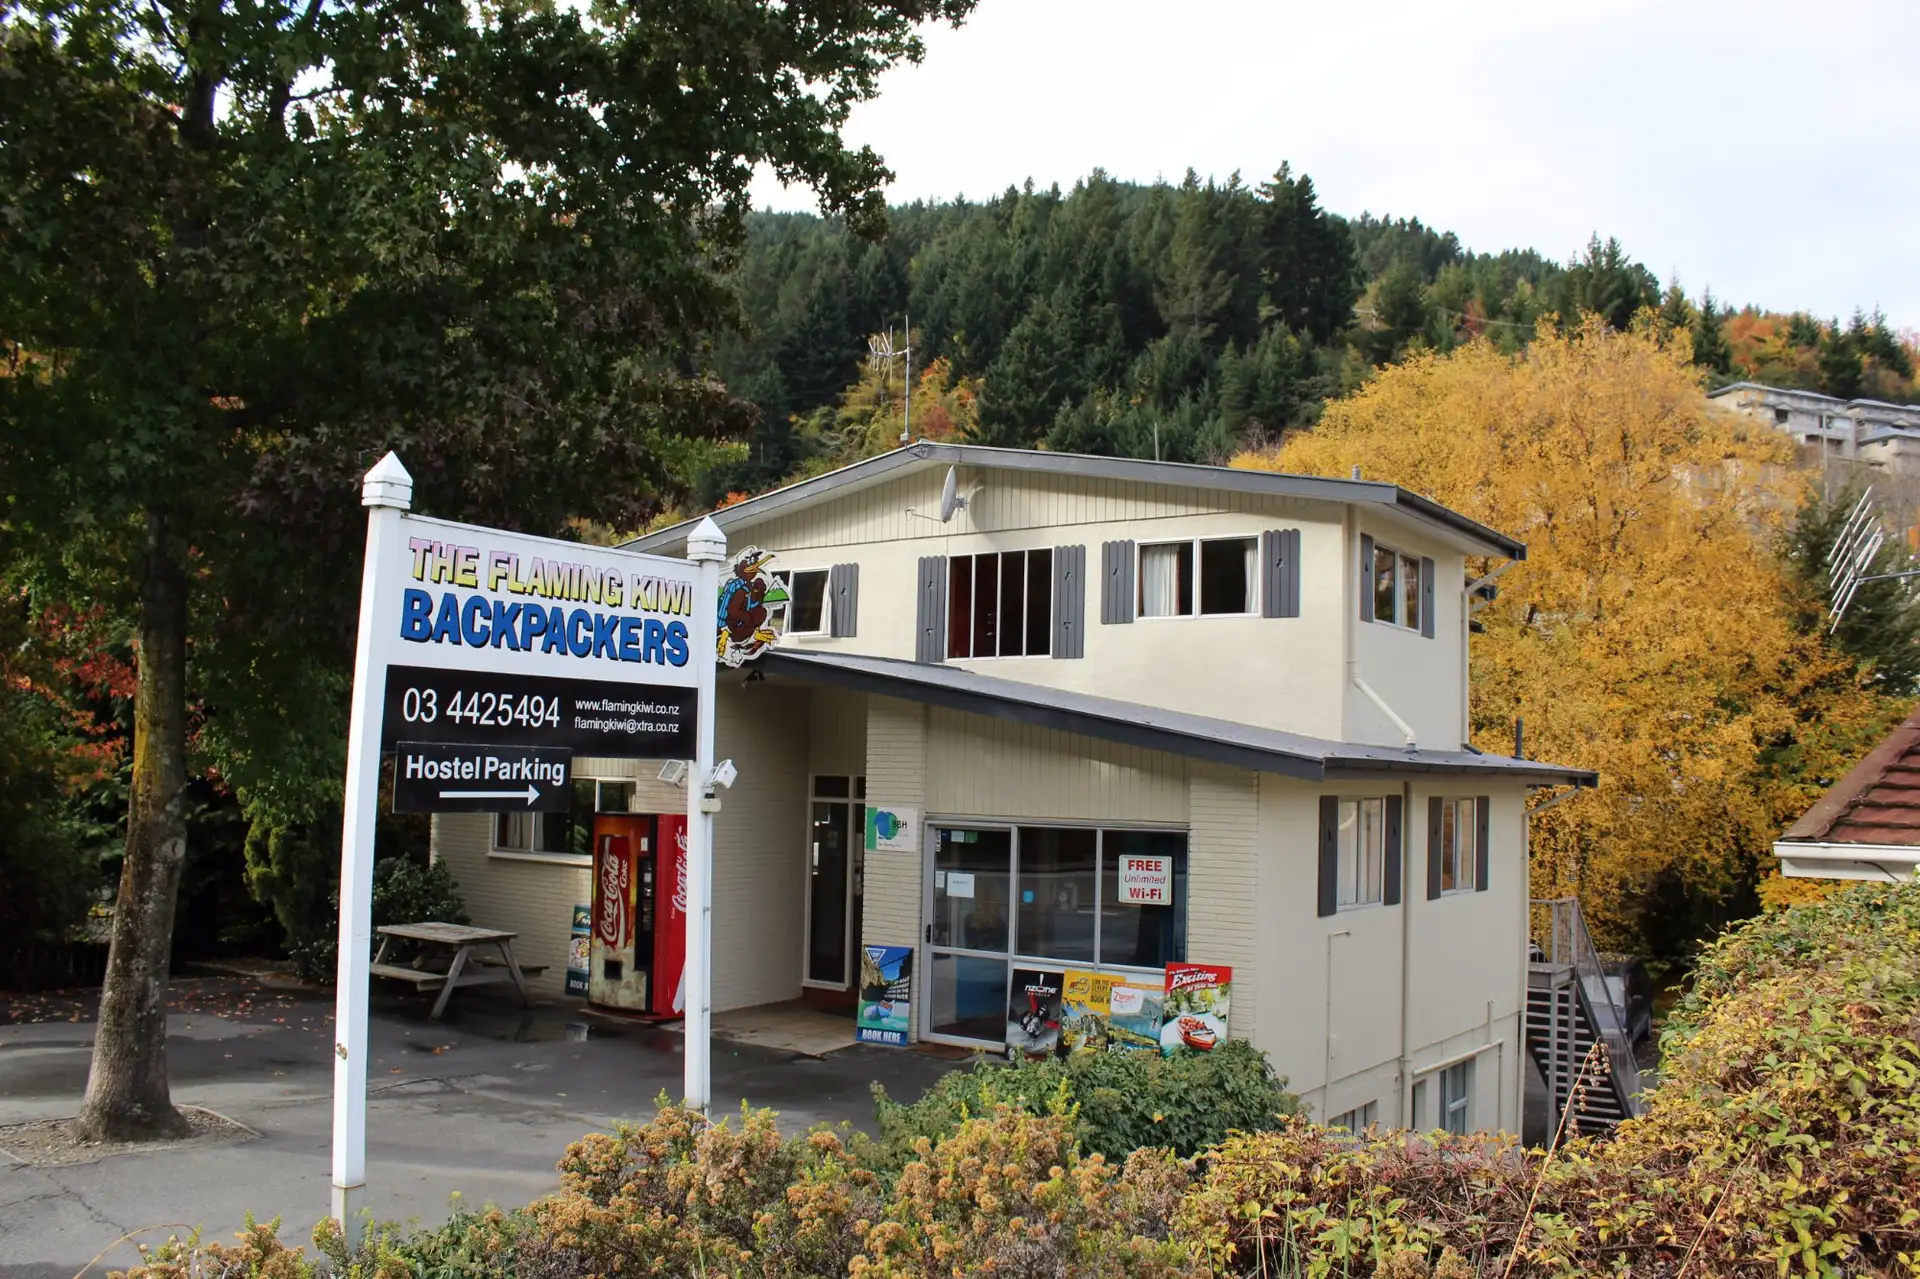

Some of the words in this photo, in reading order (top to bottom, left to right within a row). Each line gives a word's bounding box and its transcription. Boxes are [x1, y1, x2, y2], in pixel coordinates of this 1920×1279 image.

[409, 536, 479, 588] THE
[487, 550, 623, 607] FLAMING
[630, 574, 692, 616] KIWI
[400, 588, 689, 667] BACKPACKERS
[403, 688, 437, 723] 03
[446, 690, 560, 728] 4425494
[575, 699, 679, 715] www.flamingkiwi.co.nz
[574, 716, 679, 734] flamingkiwi@xtra.co.nz
[406, 755, 480, 779] Hostel
[484, 756, 565, 786] Parking
[620, 859, 628, 889] Coke
[1128, 860, 1162, 872] FREE
[1124, 874, 1166, 884] Unlimited
[600, 853, 619, 942] Coca-Cola
[1129, 887, 1162, 900] Wi-Fi
[862, 1028, 883, 1040] BOOK
[883, 1031, 902, 1043] HERE
